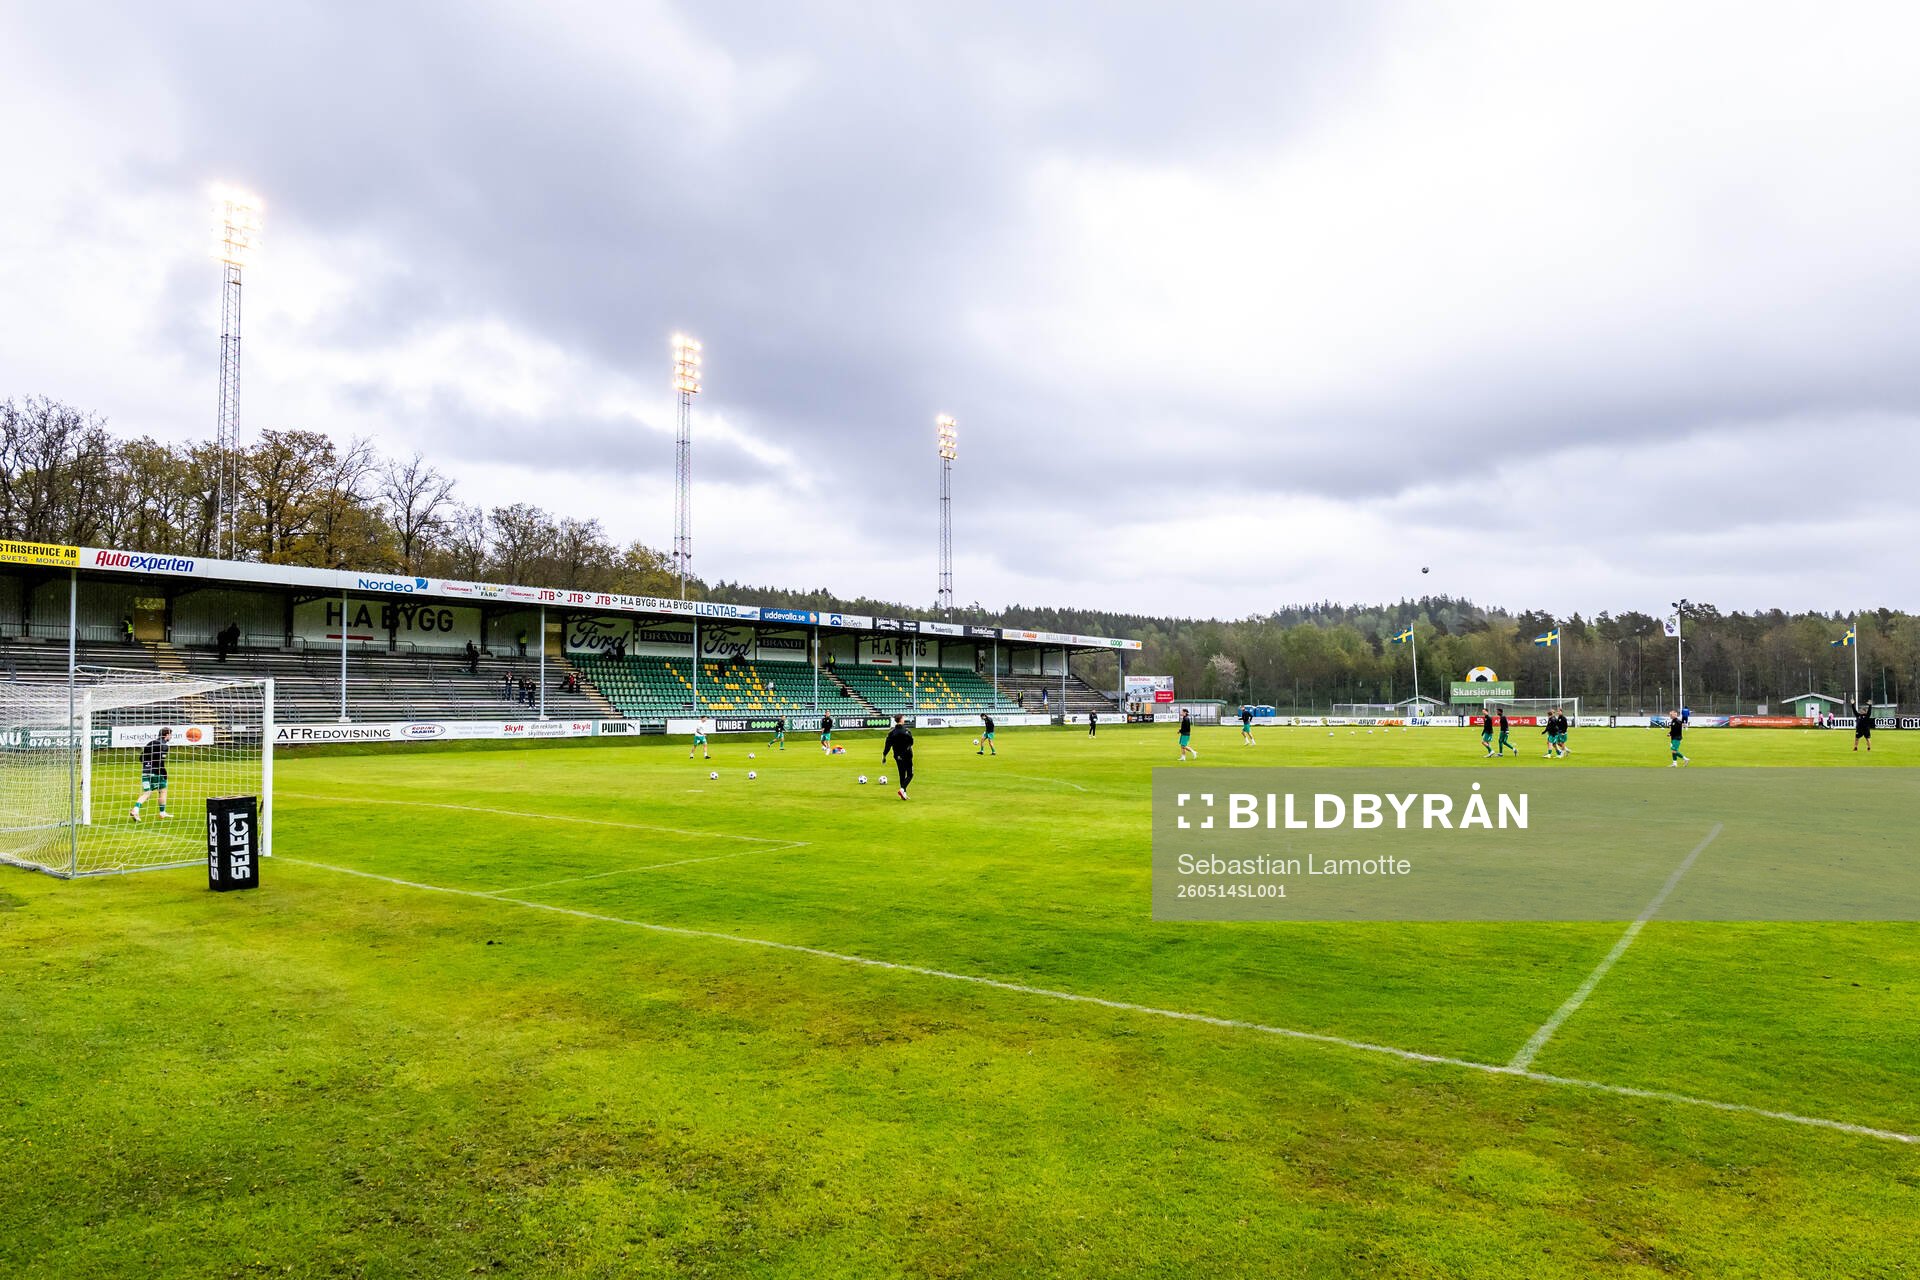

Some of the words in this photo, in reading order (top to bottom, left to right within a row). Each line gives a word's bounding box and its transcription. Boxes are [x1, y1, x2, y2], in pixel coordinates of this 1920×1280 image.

[64, 549, 77, 558] AB
[1, 554, 28, 562] SVETS
[36, 557, 76, 566] MONTAGE
[95, 550, 194, 572] Autoexperten
[358, 578, 414, 592] Nordea
[538, 590, 555, 601] JTB
[567, 593, 584, 603] JTB
[595, 595, 611, 605] JTB
[620, 596, 634, 606] H.A
[636, 597, 657, 608] BYGG
[659, 599, 673, 609] H.A
[674, 601, 693, 610] BYGG
[695, 603, 737, 618] LLENTAB
[381, 602, 454, 632] BYGG
[764, 611, 806, 622] uddevalla.se
[570, 619, 630, 650] Ford
[703, 629, 753, 657] Ford
[872, 639, 892, 655] H.A
[895, 639, 927, 657] BYGG
[1110, 639, 1122, 648] coop
[1453, 687, 1512, 698] Skarsjövallen
[572, 723, 591, 732] Skylt
[601, 722, 628, 733] PUMA
[717, 720, 748, 731] UNIBET
[839, 718, 864, 728] UNIBET
[504, 724, 524, 734] Skylt
[208, 812, 219, 880] SELECT
[228, 812, 250, 880] SELECT
